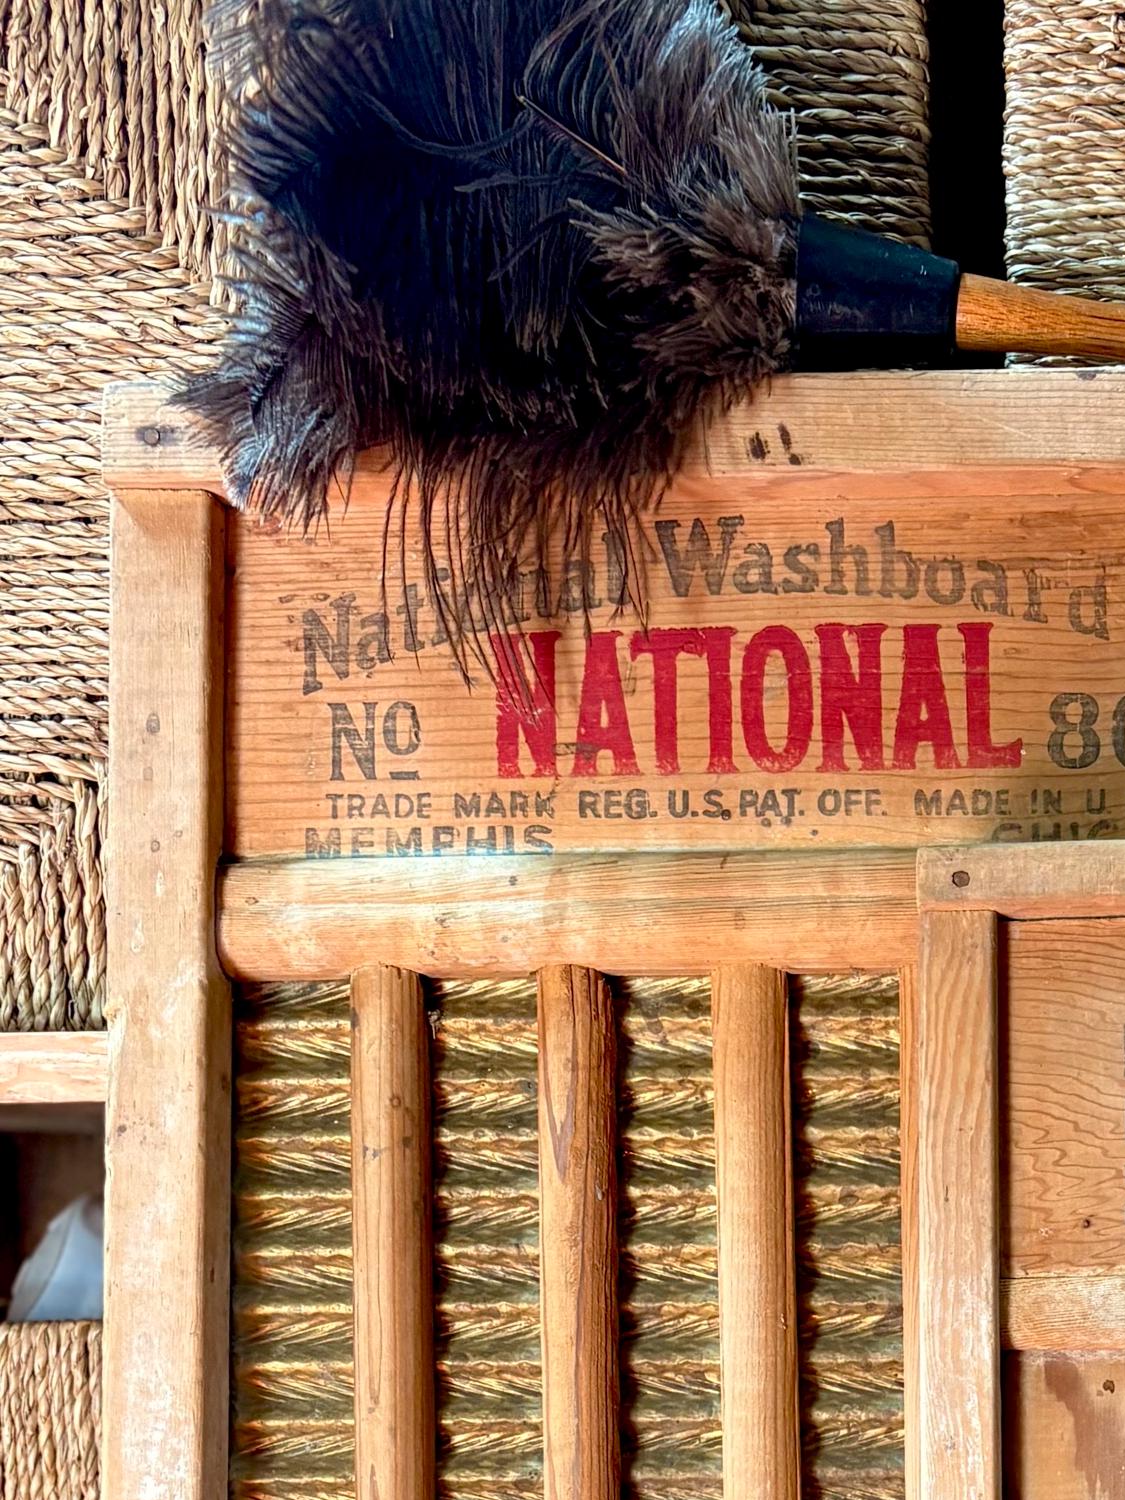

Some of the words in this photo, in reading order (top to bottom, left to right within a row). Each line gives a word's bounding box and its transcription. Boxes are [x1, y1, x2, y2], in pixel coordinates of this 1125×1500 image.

[302, 531, 631, 696] National
[655, 514, 1110, 641] Washboard
[490, 621, 1023, 779] NATIONAL
[304, 825, 555, 858] MEMPHIS
[325, 792, 432, 820] TRADE
[453, 790, 555, 820] MARK
[913, 788, 1011, 817] MADE
[1030, 789, 1062, 815] IN
